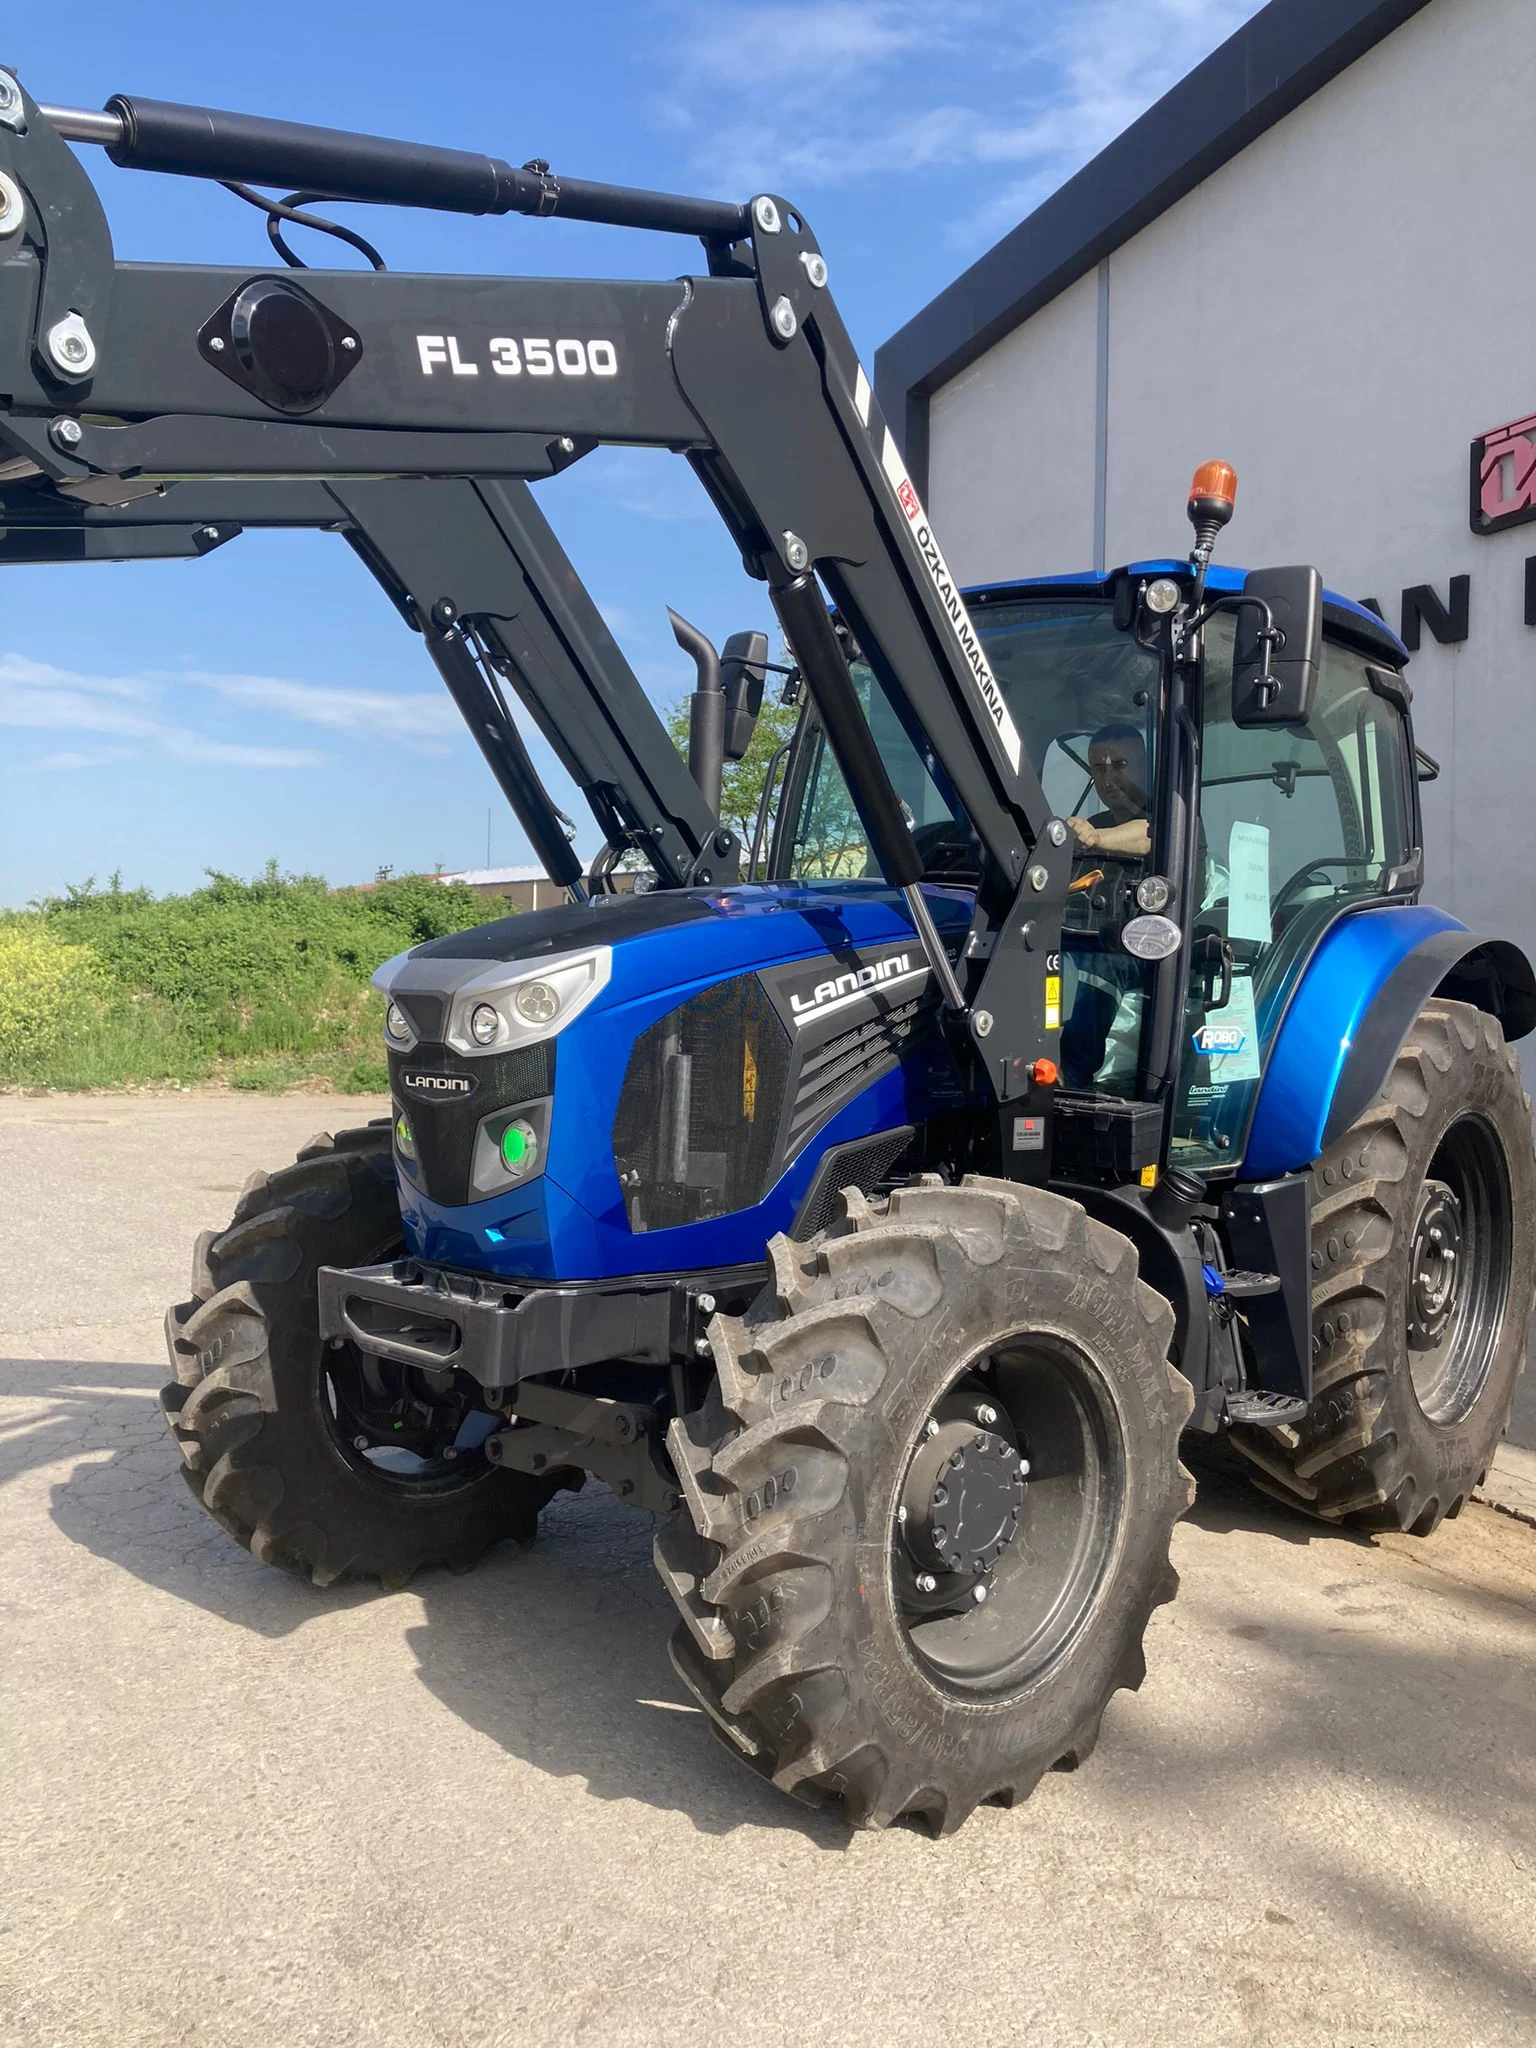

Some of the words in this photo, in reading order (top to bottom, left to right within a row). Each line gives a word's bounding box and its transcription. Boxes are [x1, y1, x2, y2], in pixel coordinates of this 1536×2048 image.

[416, 335, 478, 375] FL
[489, 337, 618, 376] 3500
[917, 525, 961, 621] ÖZKAN
[958, 623, 1004, 727] MAKİNA
[789, 953, 911, 1013] LANDINI
[1046, 954, 1059, 971] CE
[1201, 1030, 1238, 1050] ROBO
[405, 1074, 471, 1092] LANDINI
[1125, 1338, 1169, 1430] MAX
